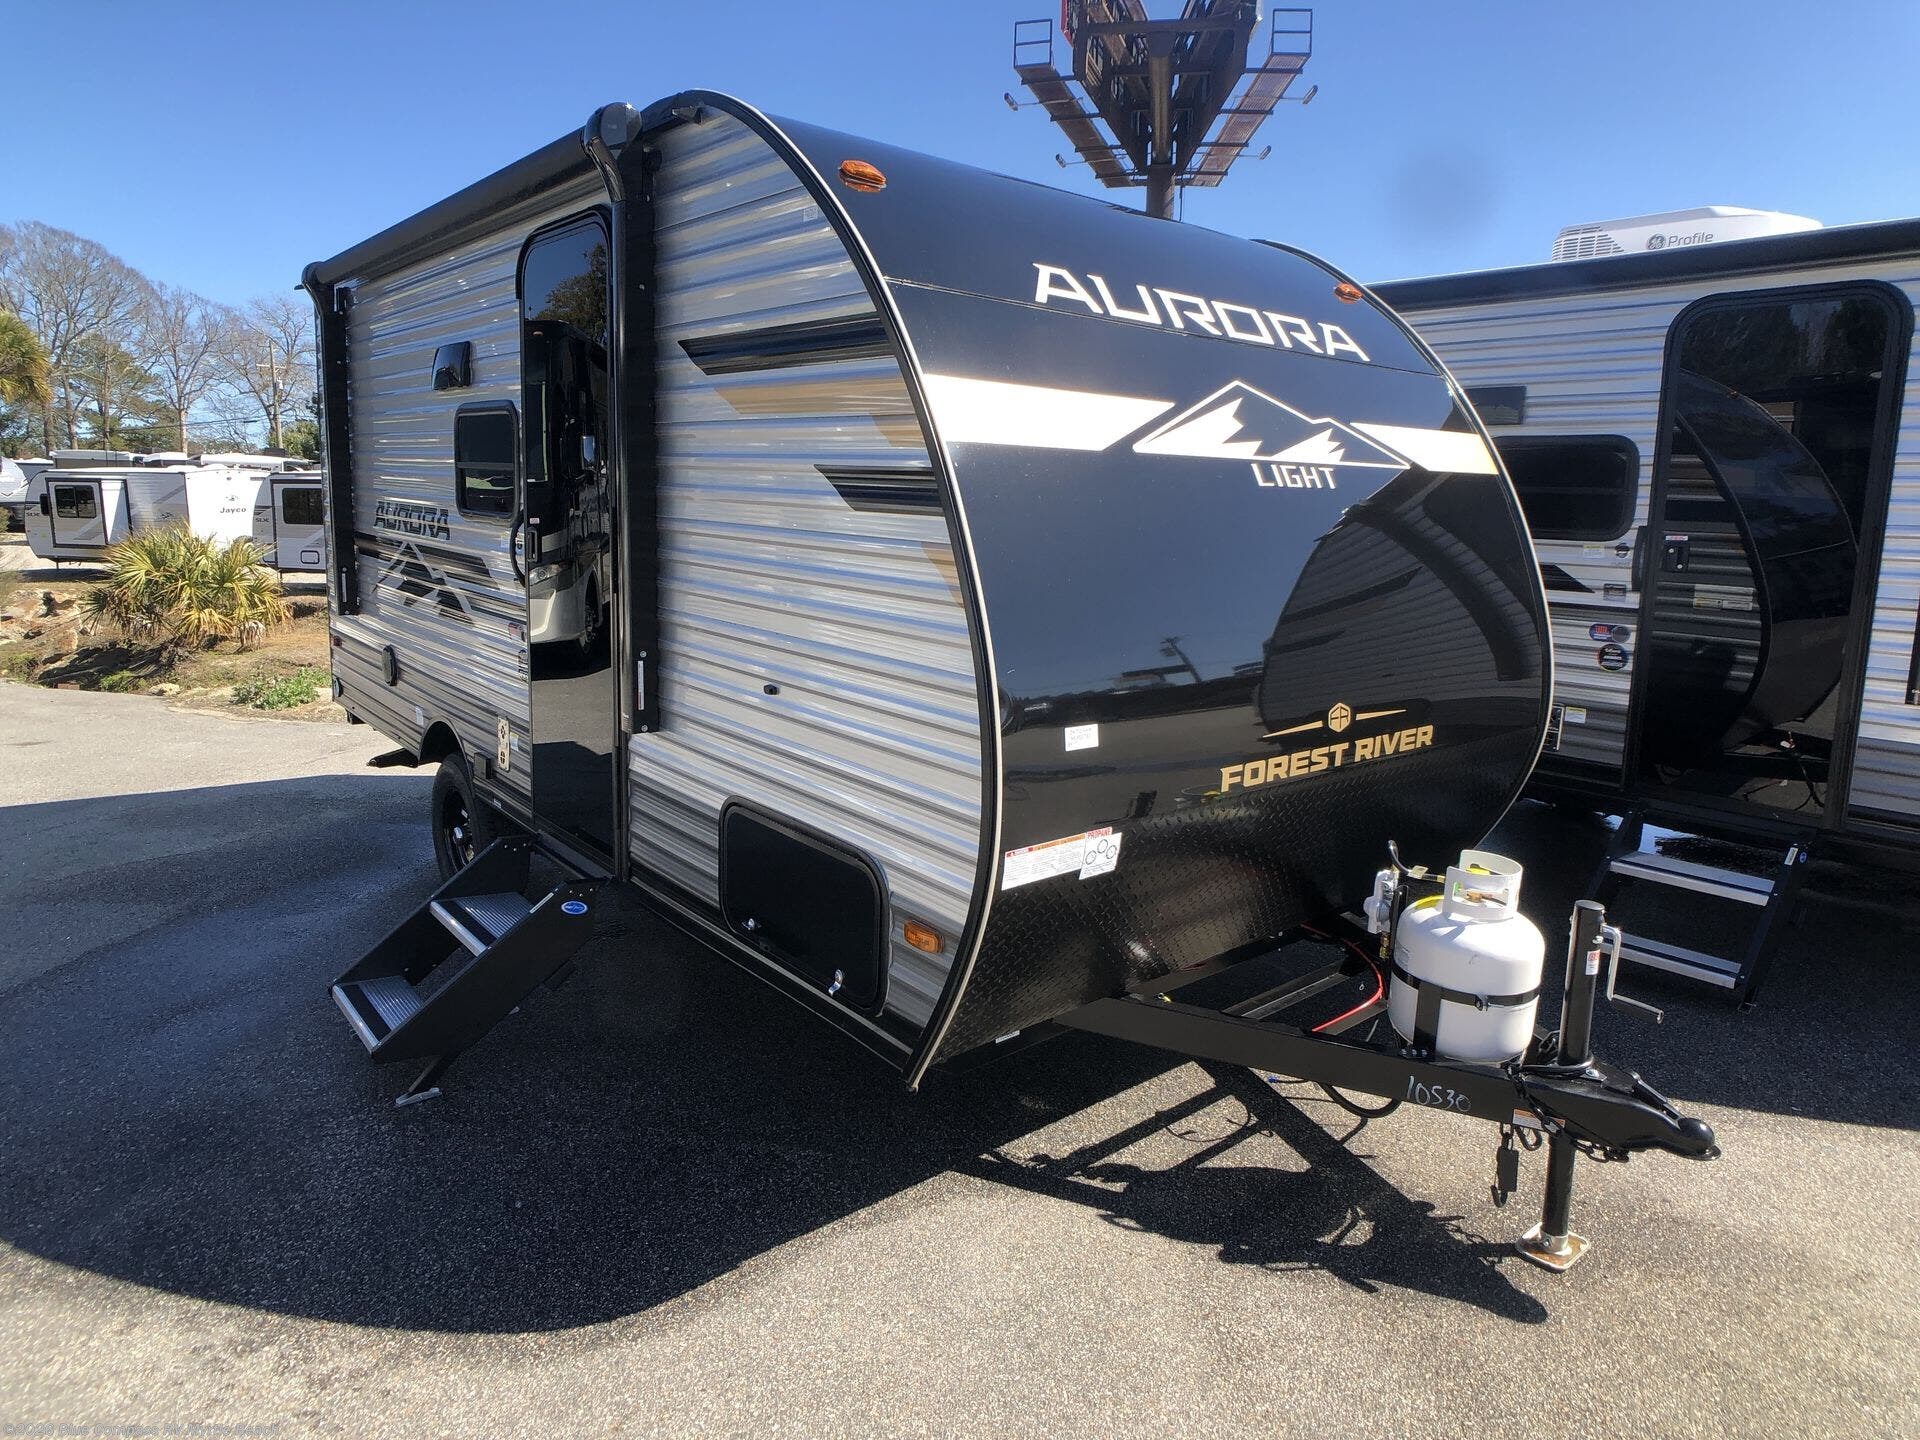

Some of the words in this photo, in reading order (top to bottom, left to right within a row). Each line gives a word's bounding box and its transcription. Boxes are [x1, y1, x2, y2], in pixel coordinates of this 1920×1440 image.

[1667, 231, 1714, 248] Profile
[1031, 262, 1371, 362] AURORA
[1249, 462, 1337, 490] LIGHT
[219, 506, 247, 516] Jayco
[373, 500, 453, 541] AURORA
[1219, 742, 1349, 793] FOREST
[1354, 724, 1434, 763] RIVER
[1087, 827, 1112, 840] PROPANE
